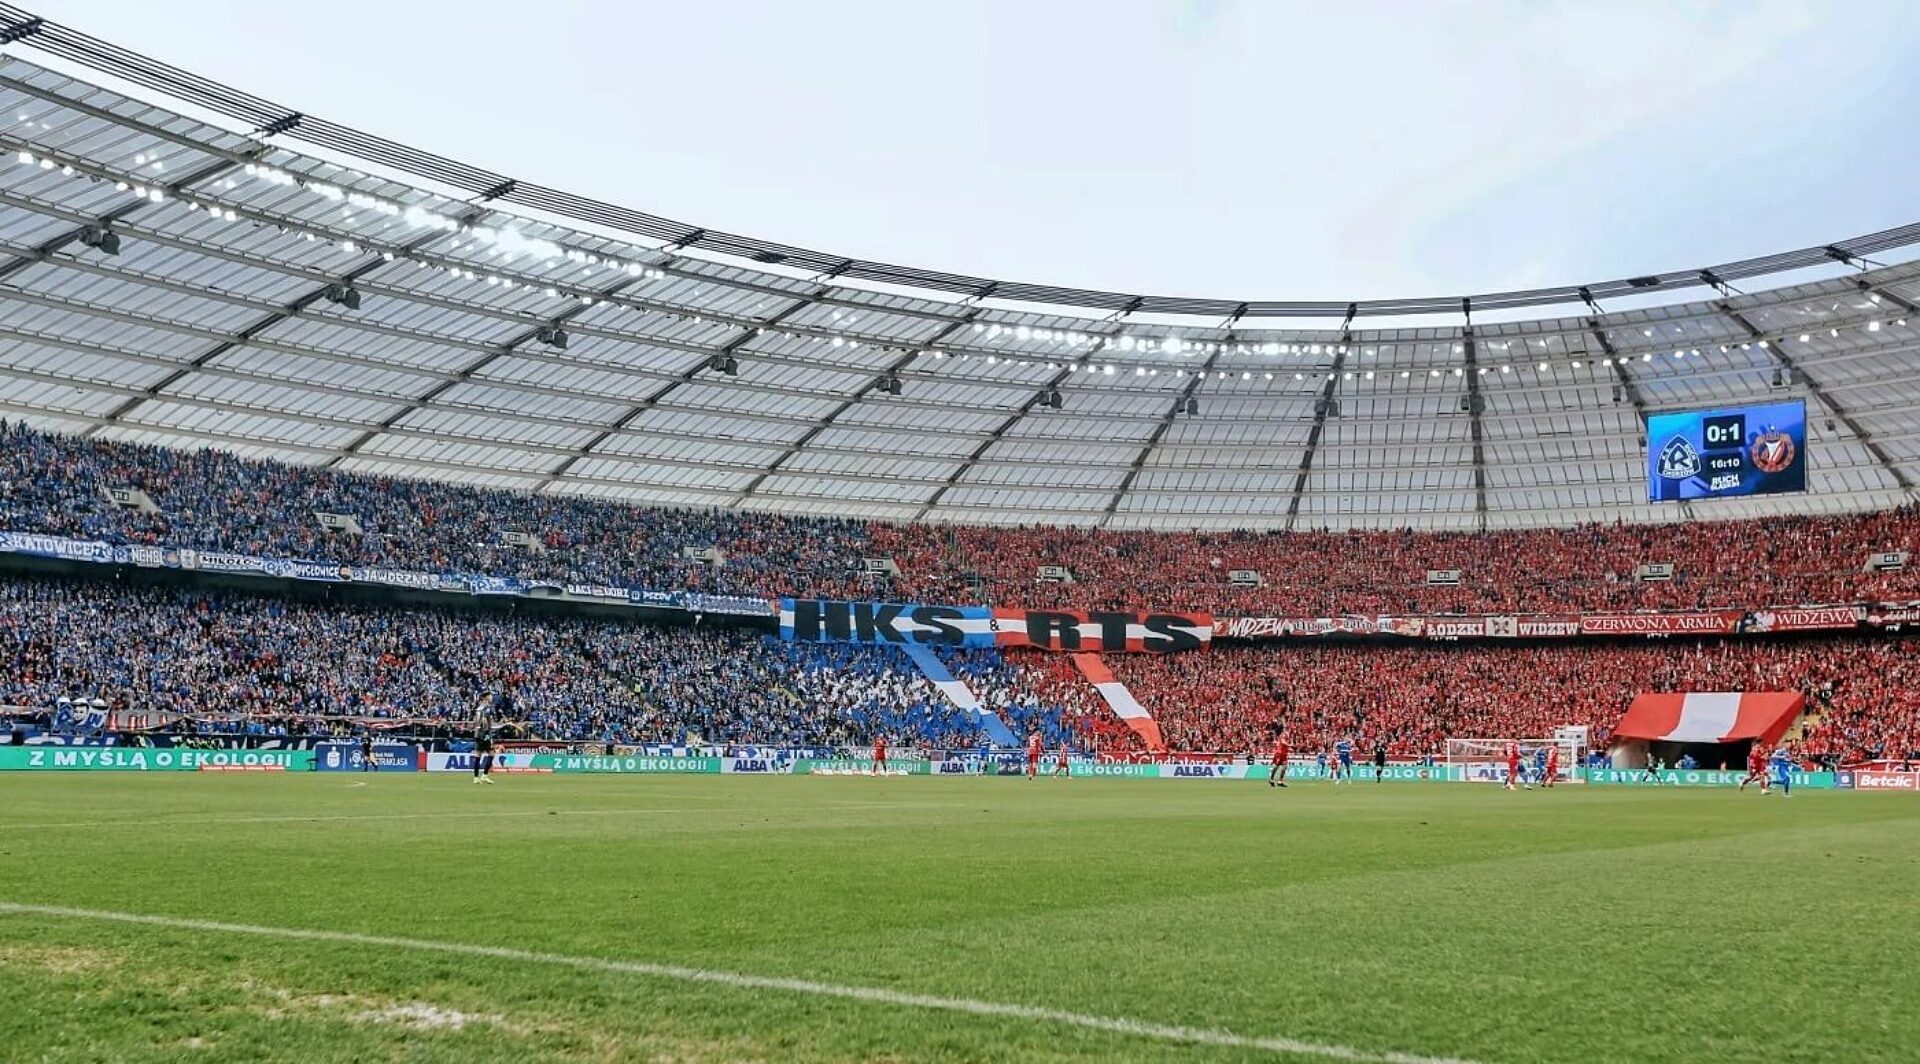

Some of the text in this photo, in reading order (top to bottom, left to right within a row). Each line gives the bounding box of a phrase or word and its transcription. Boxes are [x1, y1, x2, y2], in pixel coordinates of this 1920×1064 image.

[1706, 423, 1740, 442] 0:1
[1710, 458, 1740, 469] 16:10
[14, 534, 93, 556] KATOWICE
[1582, 613, 1726, 633] CZERWONA ARMIA
[1777, 609, 1857, 626] WIDZEWA
[794, 600, 1207, 652] HKS & RTS
[1518, 622, 1578, 636] WIDZEW
[29, 748, 292, 769] Z MYŚLĄ O EKOLOGII
[553, 755, 708, 772] Z MYŚLĄ O EKOLOGII
[733, 760, 768, 772] ALBA
[940, 760, 966, 773] ALBA
[1077, 765, 1144, 775] EKOLOGII
[1174, 765, 1215, 777] ALBA
[1359, 768, 1441, 779] EKOLOII
[1593, 771, 1605, 781] Z
[1686, 772, 1700, 784] O
[1860, 774, 1912, 788] Betclic
